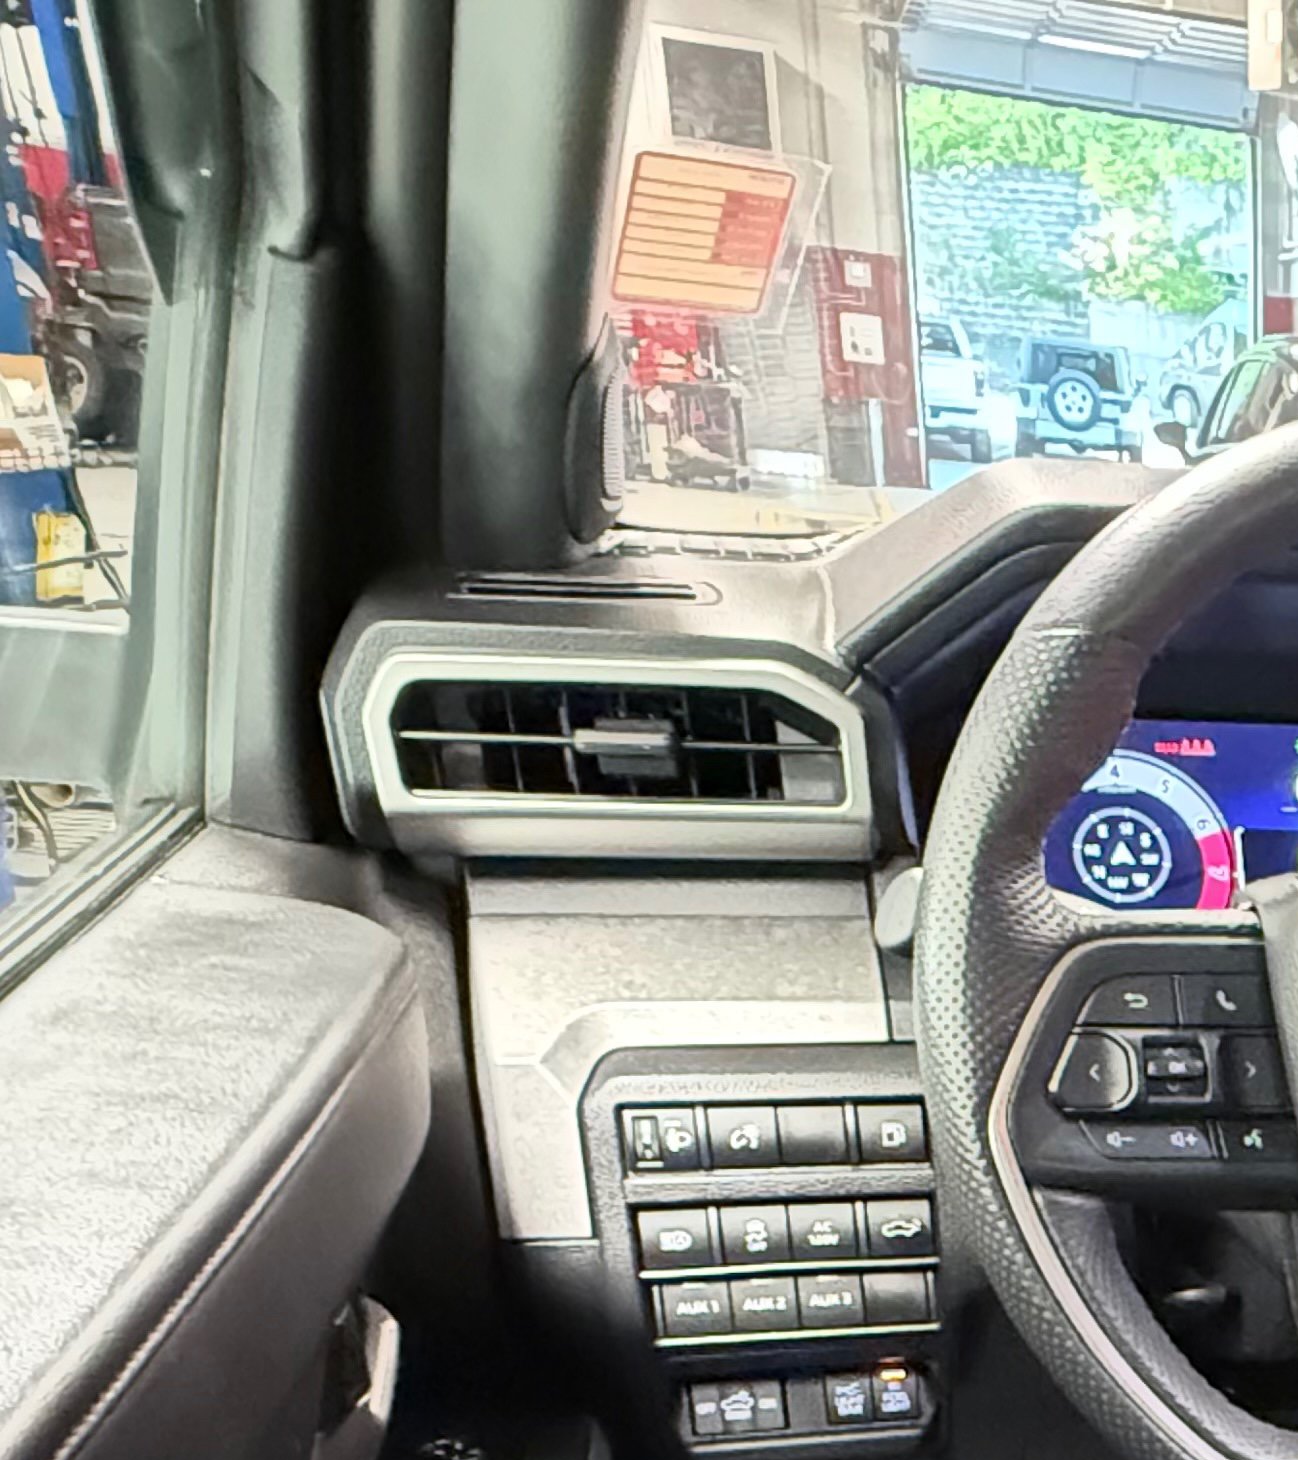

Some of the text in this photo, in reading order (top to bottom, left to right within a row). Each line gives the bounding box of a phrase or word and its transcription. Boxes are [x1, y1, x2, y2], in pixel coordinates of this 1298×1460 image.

[1110, 764, 1120, 778] 4
[1161, 779, 1171, 794] 5
[676, 1300, 709, 1316] AUX
[742, 1296, 787, 1311] AUX 2
[808, 1294, 840, 1308] AUX
